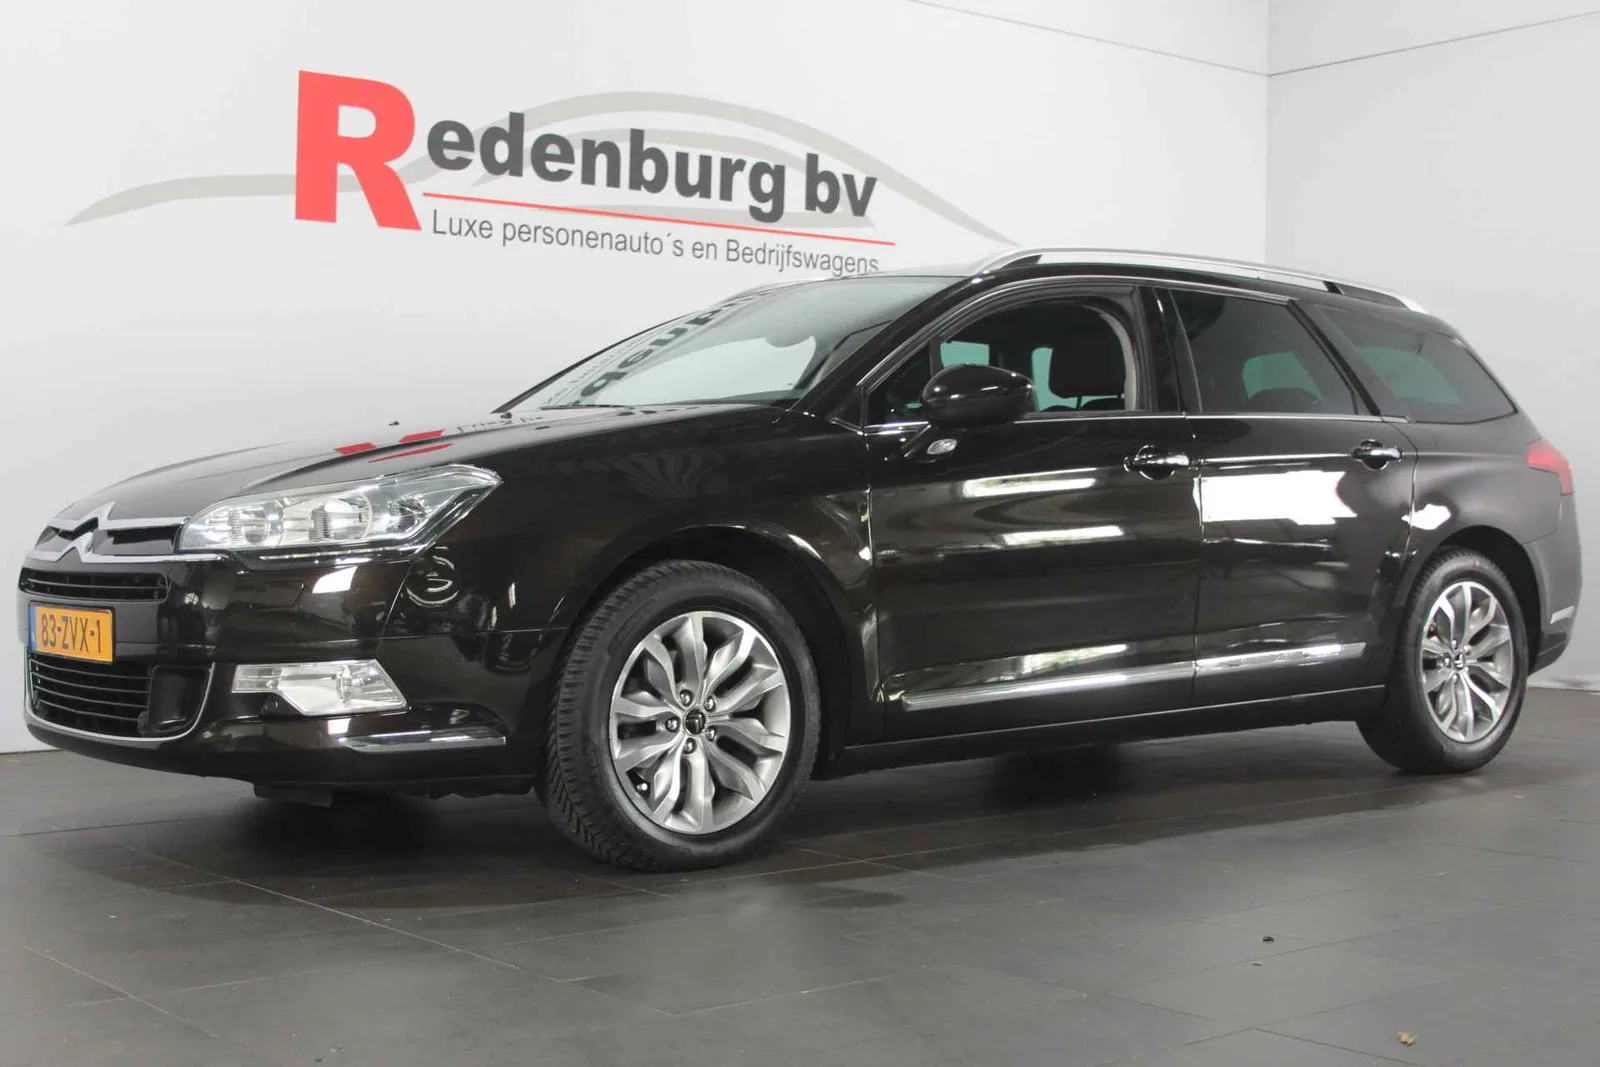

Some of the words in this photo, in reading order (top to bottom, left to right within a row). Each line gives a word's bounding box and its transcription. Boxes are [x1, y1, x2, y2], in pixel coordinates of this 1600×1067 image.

[295, 70, 785, 231] Redenburg
[804, 153, 878, 217] bv
[432, 209, 493, 239] Luxe
[691, 239, 718, 260] en
[726, 239, 879, 277] Bedrijfswagens
[41, 613, 101, 654] 83-ZVX-1
